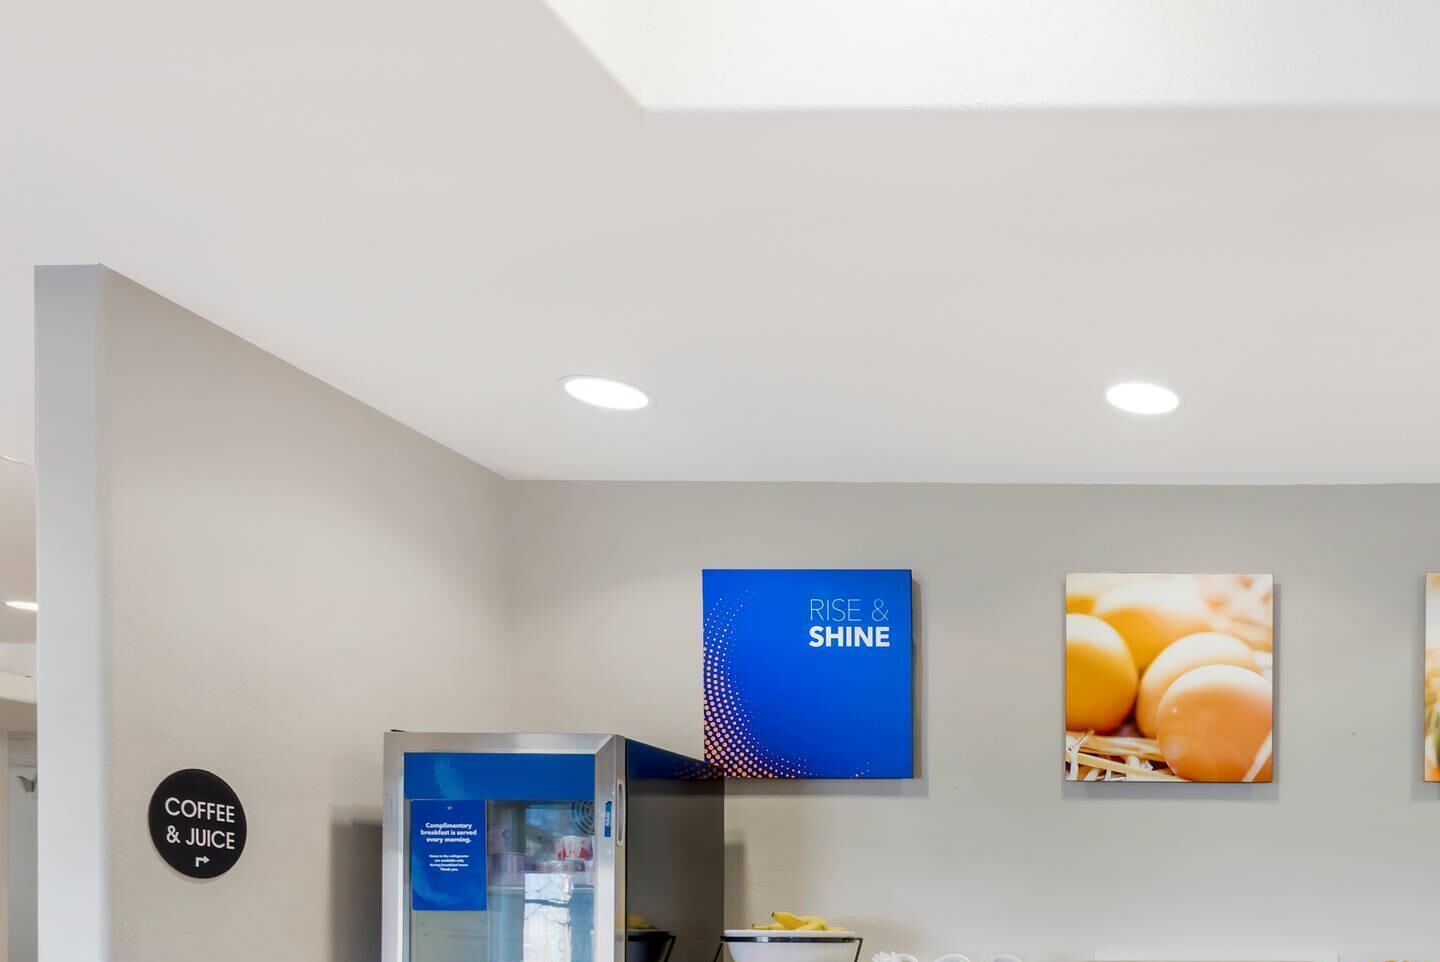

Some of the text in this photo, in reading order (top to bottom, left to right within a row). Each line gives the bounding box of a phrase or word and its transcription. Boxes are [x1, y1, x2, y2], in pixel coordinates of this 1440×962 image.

[810, 598, 889, 622] RISE &
[808, 625, 890, 648] SHINE
[164, 797, 235, 823] COFFEE
[166, 825, 235, 850] & JUICE
[420, 828, 449, 836] breakfast
